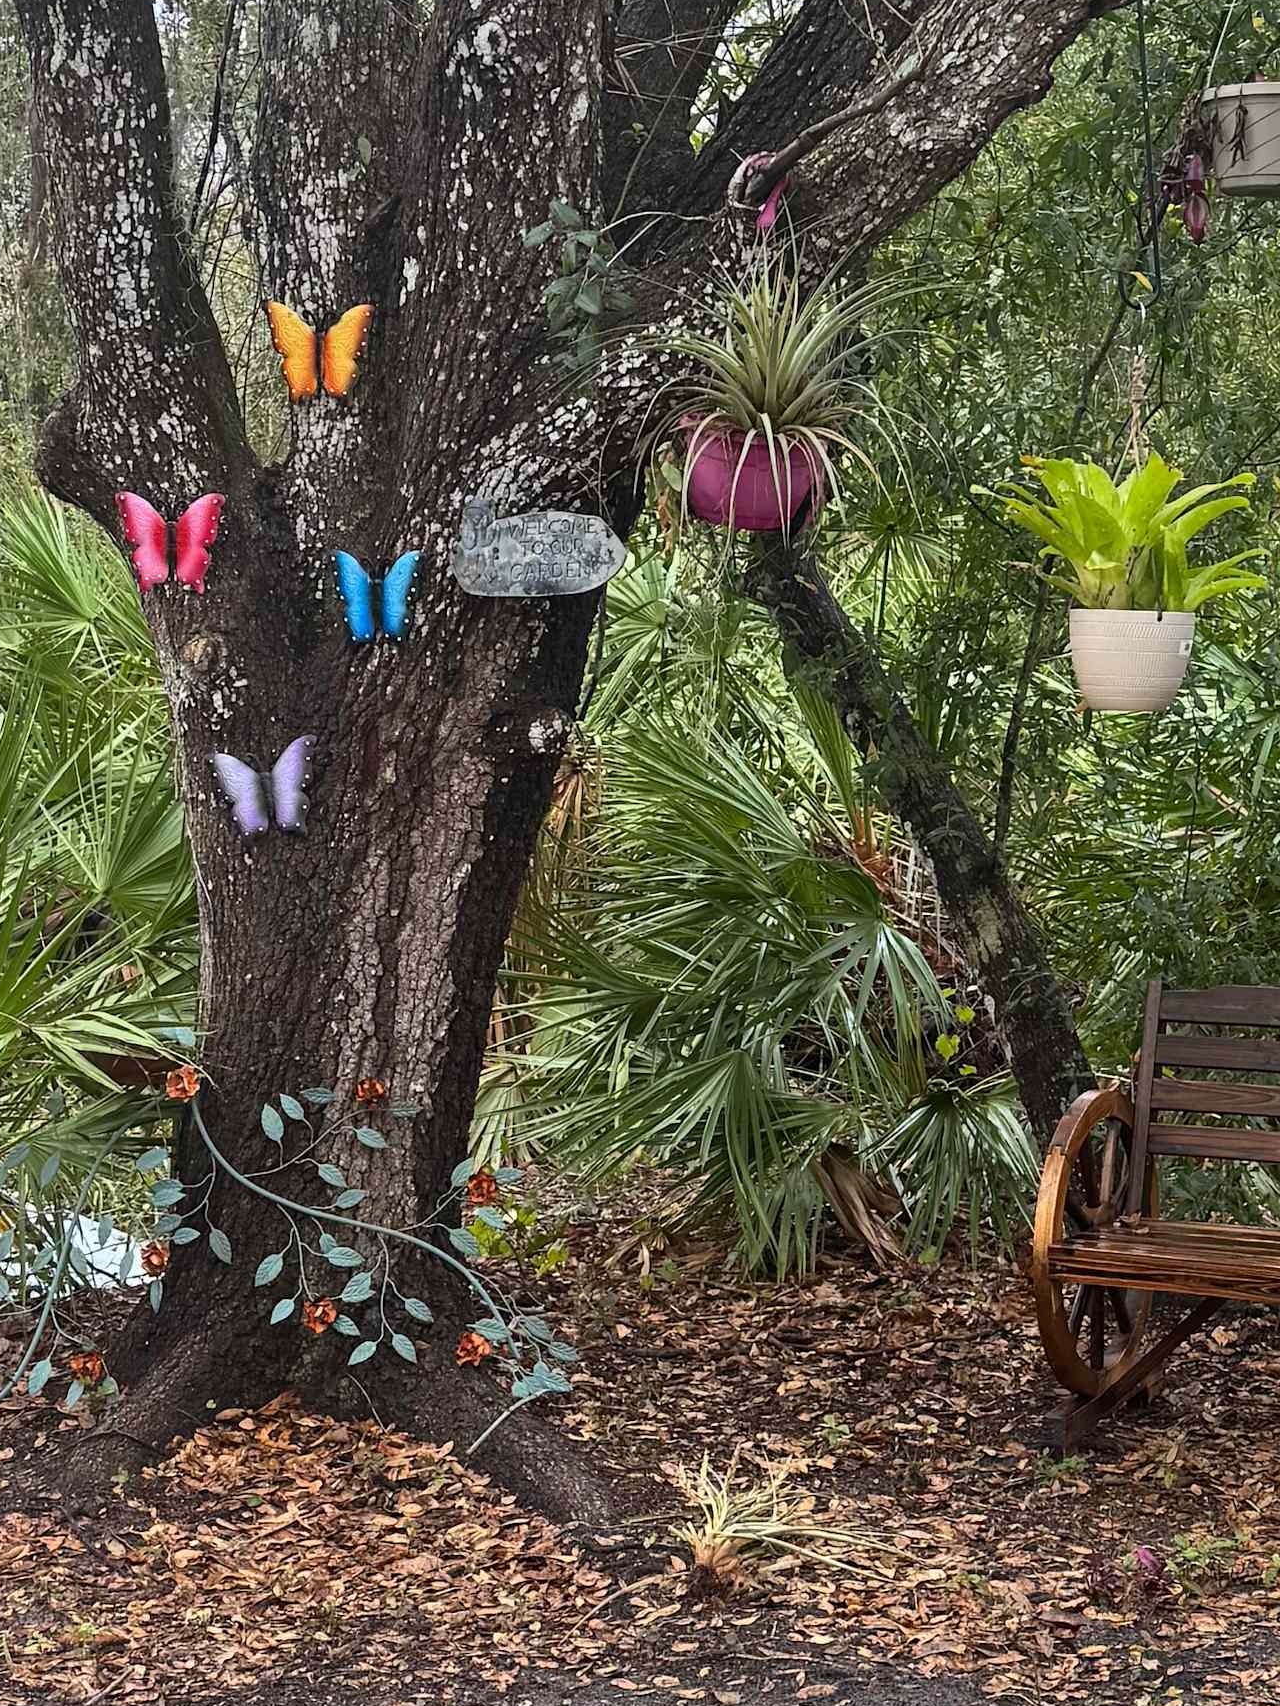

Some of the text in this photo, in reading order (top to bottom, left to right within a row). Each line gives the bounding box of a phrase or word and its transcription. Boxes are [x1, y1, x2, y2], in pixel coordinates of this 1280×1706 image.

[507, 516, 597, 539] WELCOME
[519, 537, 585, 557] TO OUR
[510, 560, 591, 582] GARDEN
